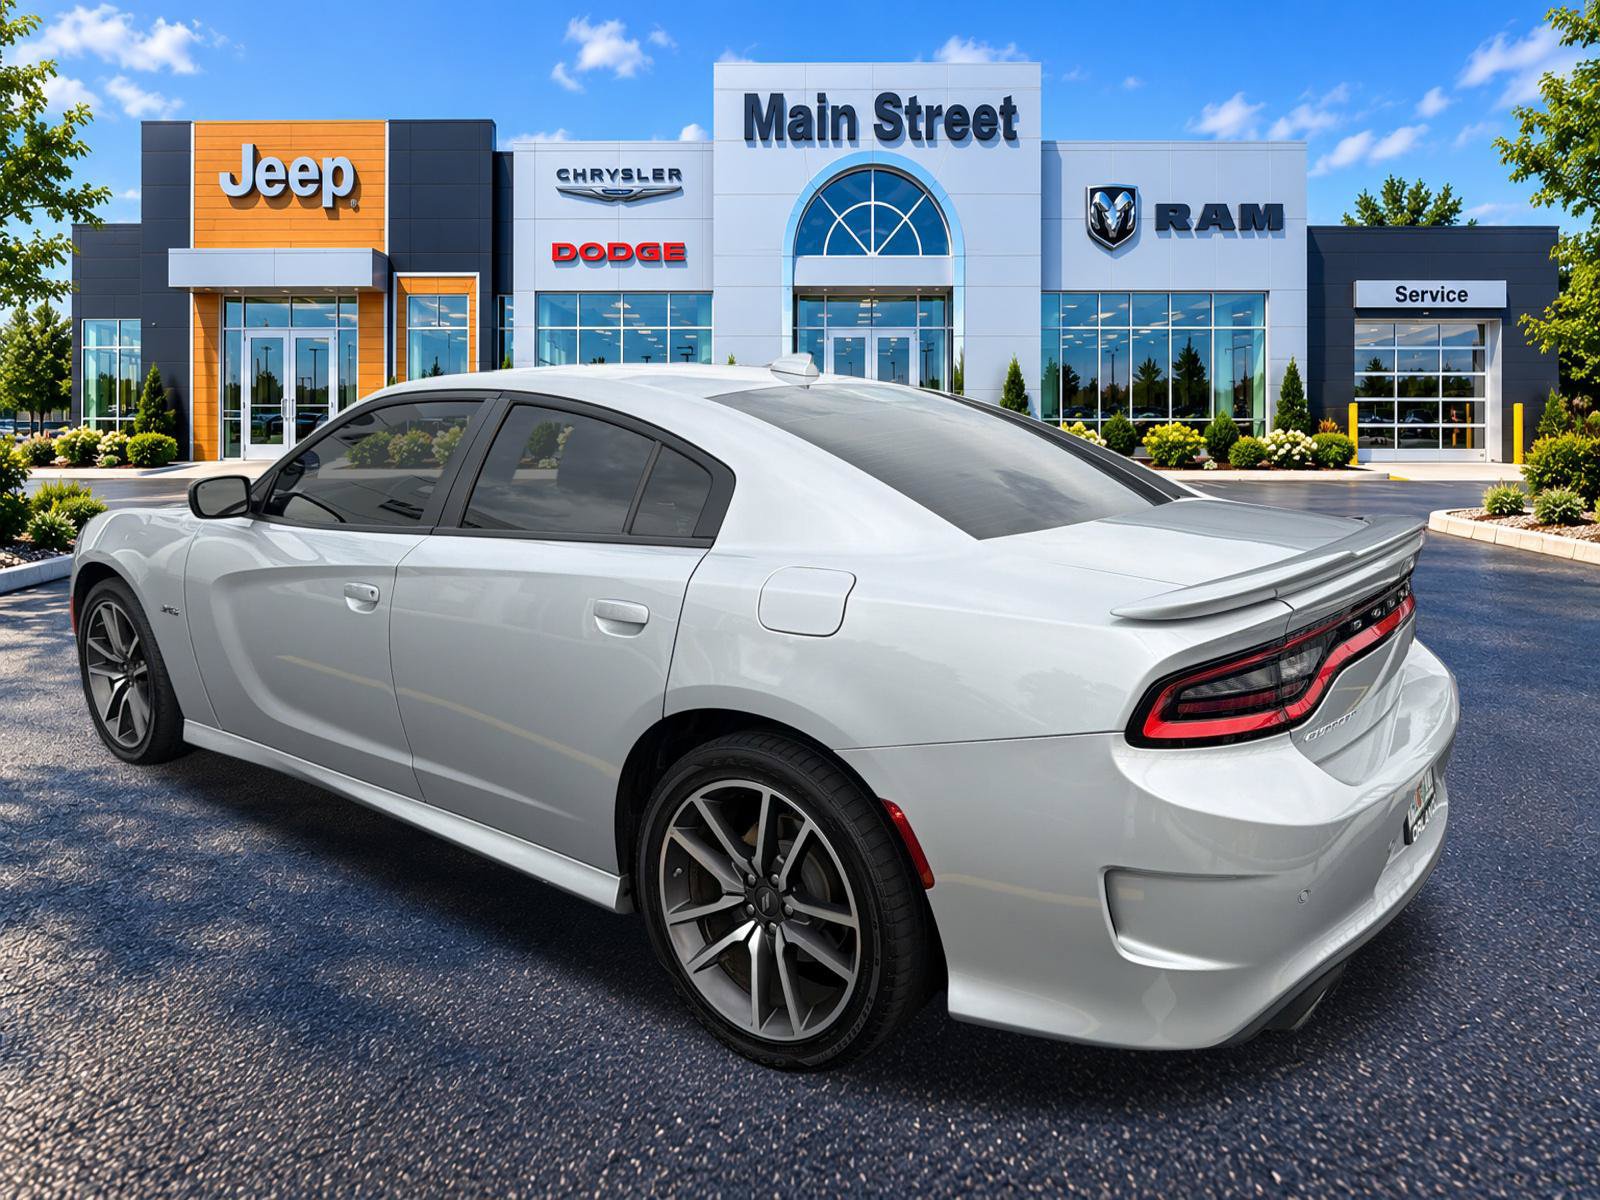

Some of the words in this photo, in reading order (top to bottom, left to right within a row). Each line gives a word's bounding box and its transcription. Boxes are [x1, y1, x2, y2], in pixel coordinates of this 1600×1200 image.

[743, 92, 858, 143] Main
[873, 91, 1018, 142] Street
[218, 143, 355, 209] Jeep
[556, 167, 683, 182] CHRYSLER
[1154, 203, 1284, 232] RAM
[551, 242, 687, 262] DODGE
[1395, 285, 1469, 303] Service
